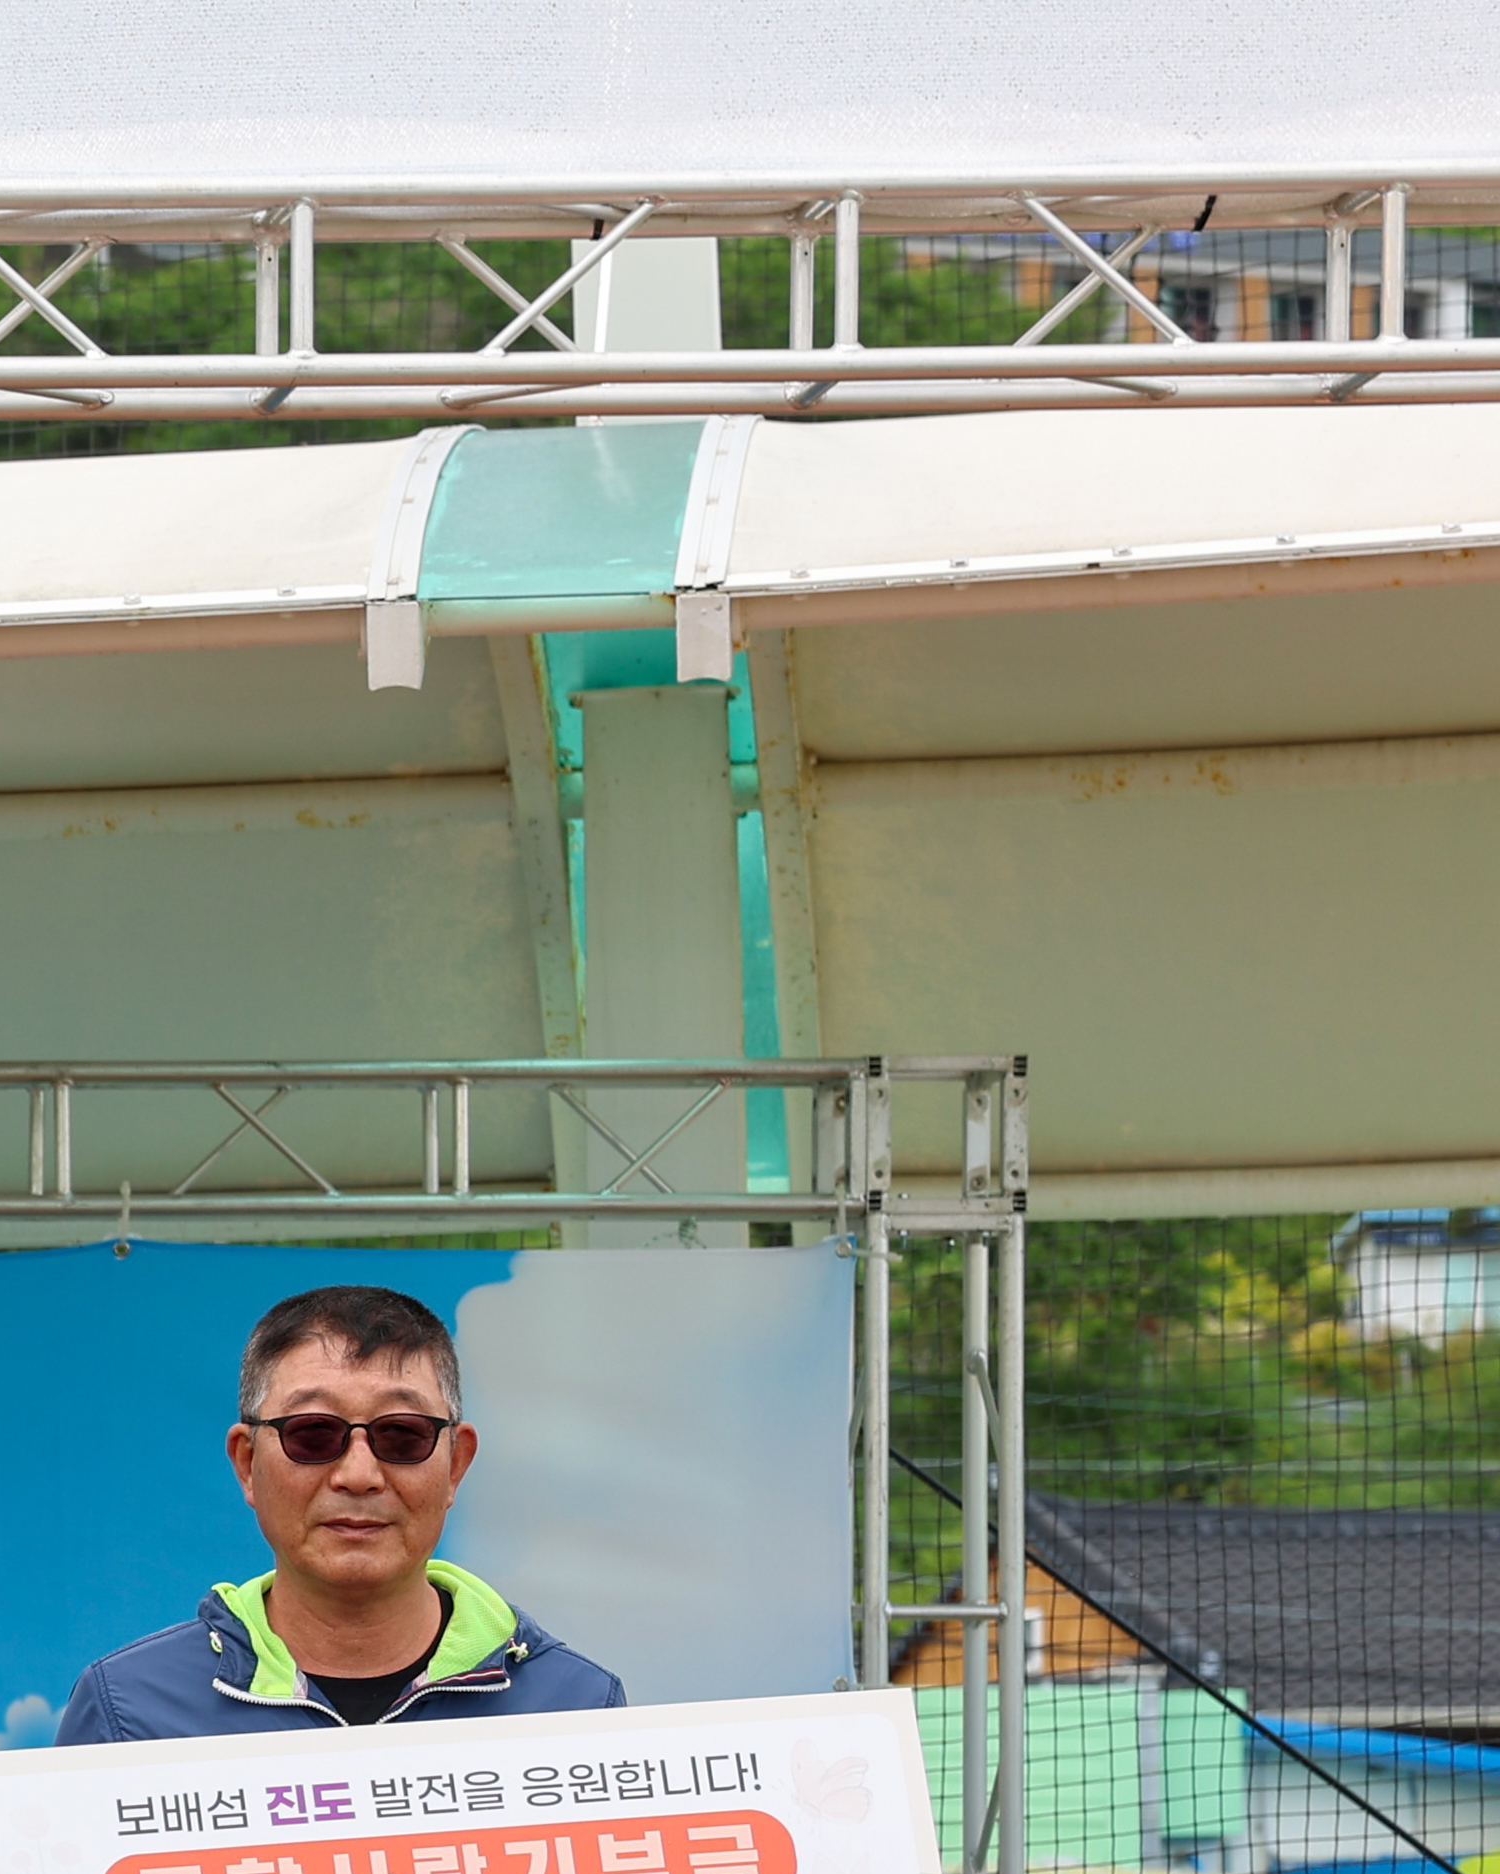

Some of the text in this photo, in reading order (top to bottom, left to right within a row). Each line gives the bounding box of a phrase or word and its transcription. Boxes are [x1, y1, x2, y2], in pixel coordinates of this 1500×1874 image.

[117, 1753, 761, 1835] 보배섬 진도 발전을 응원합니다!
